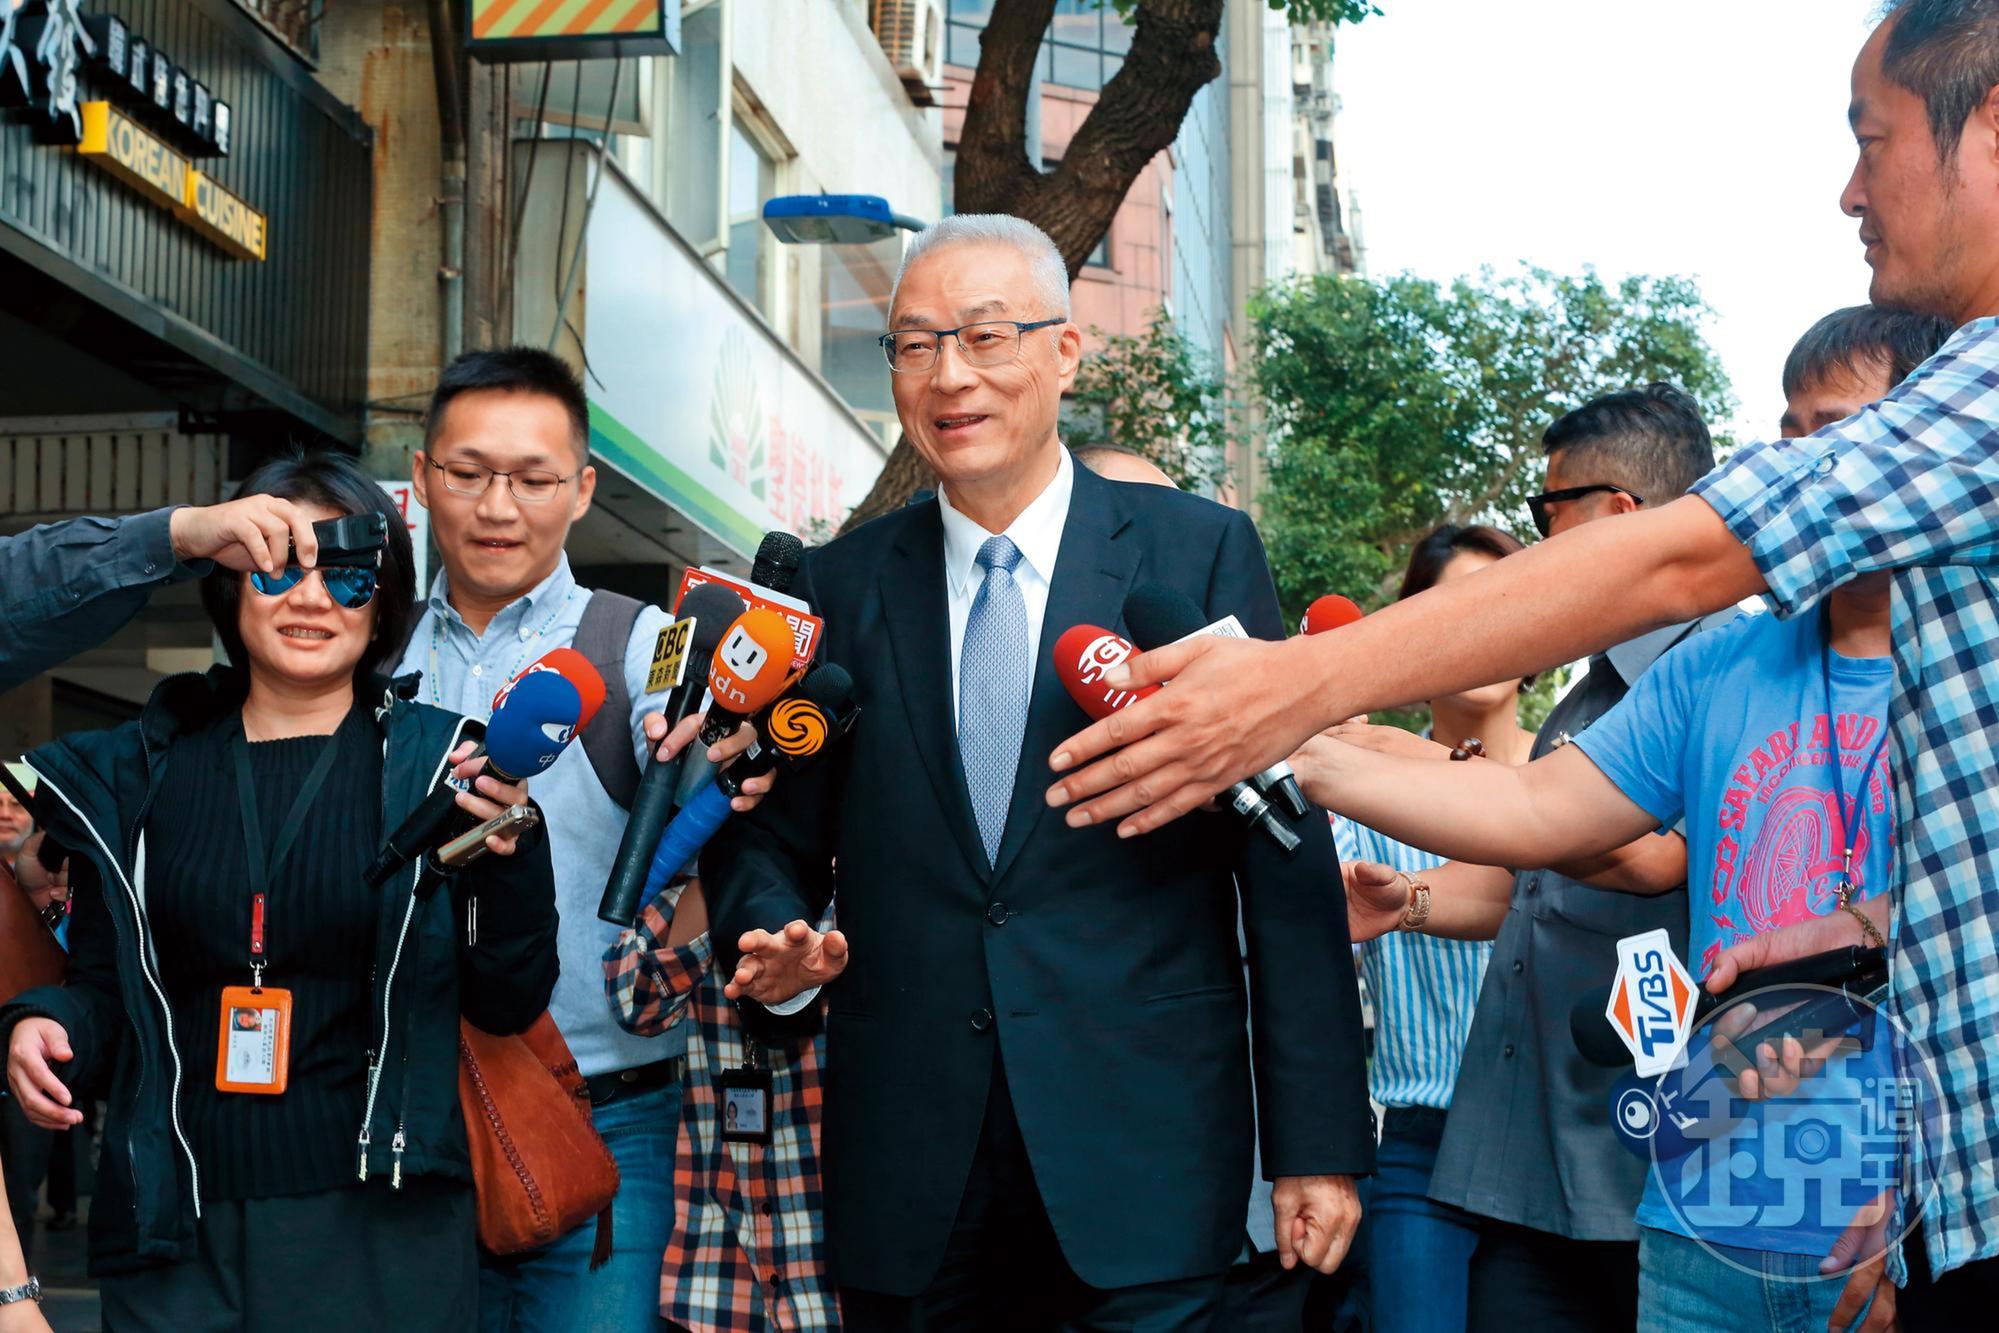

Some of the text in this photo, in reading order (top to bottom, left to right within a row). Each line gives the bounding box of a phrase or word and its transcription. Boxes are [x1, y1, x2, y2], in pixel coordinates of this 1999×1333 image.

[107, 112, 186, 204] KOREAN
[194, 176, 262, 256] CUISINE
[709, 657, 747, 704] udn
[1719, 721, 1800, 831] SAFARI
[1808, 713, 1879, 750] AND
[1634, 950, 1674, 1057] TVBS
